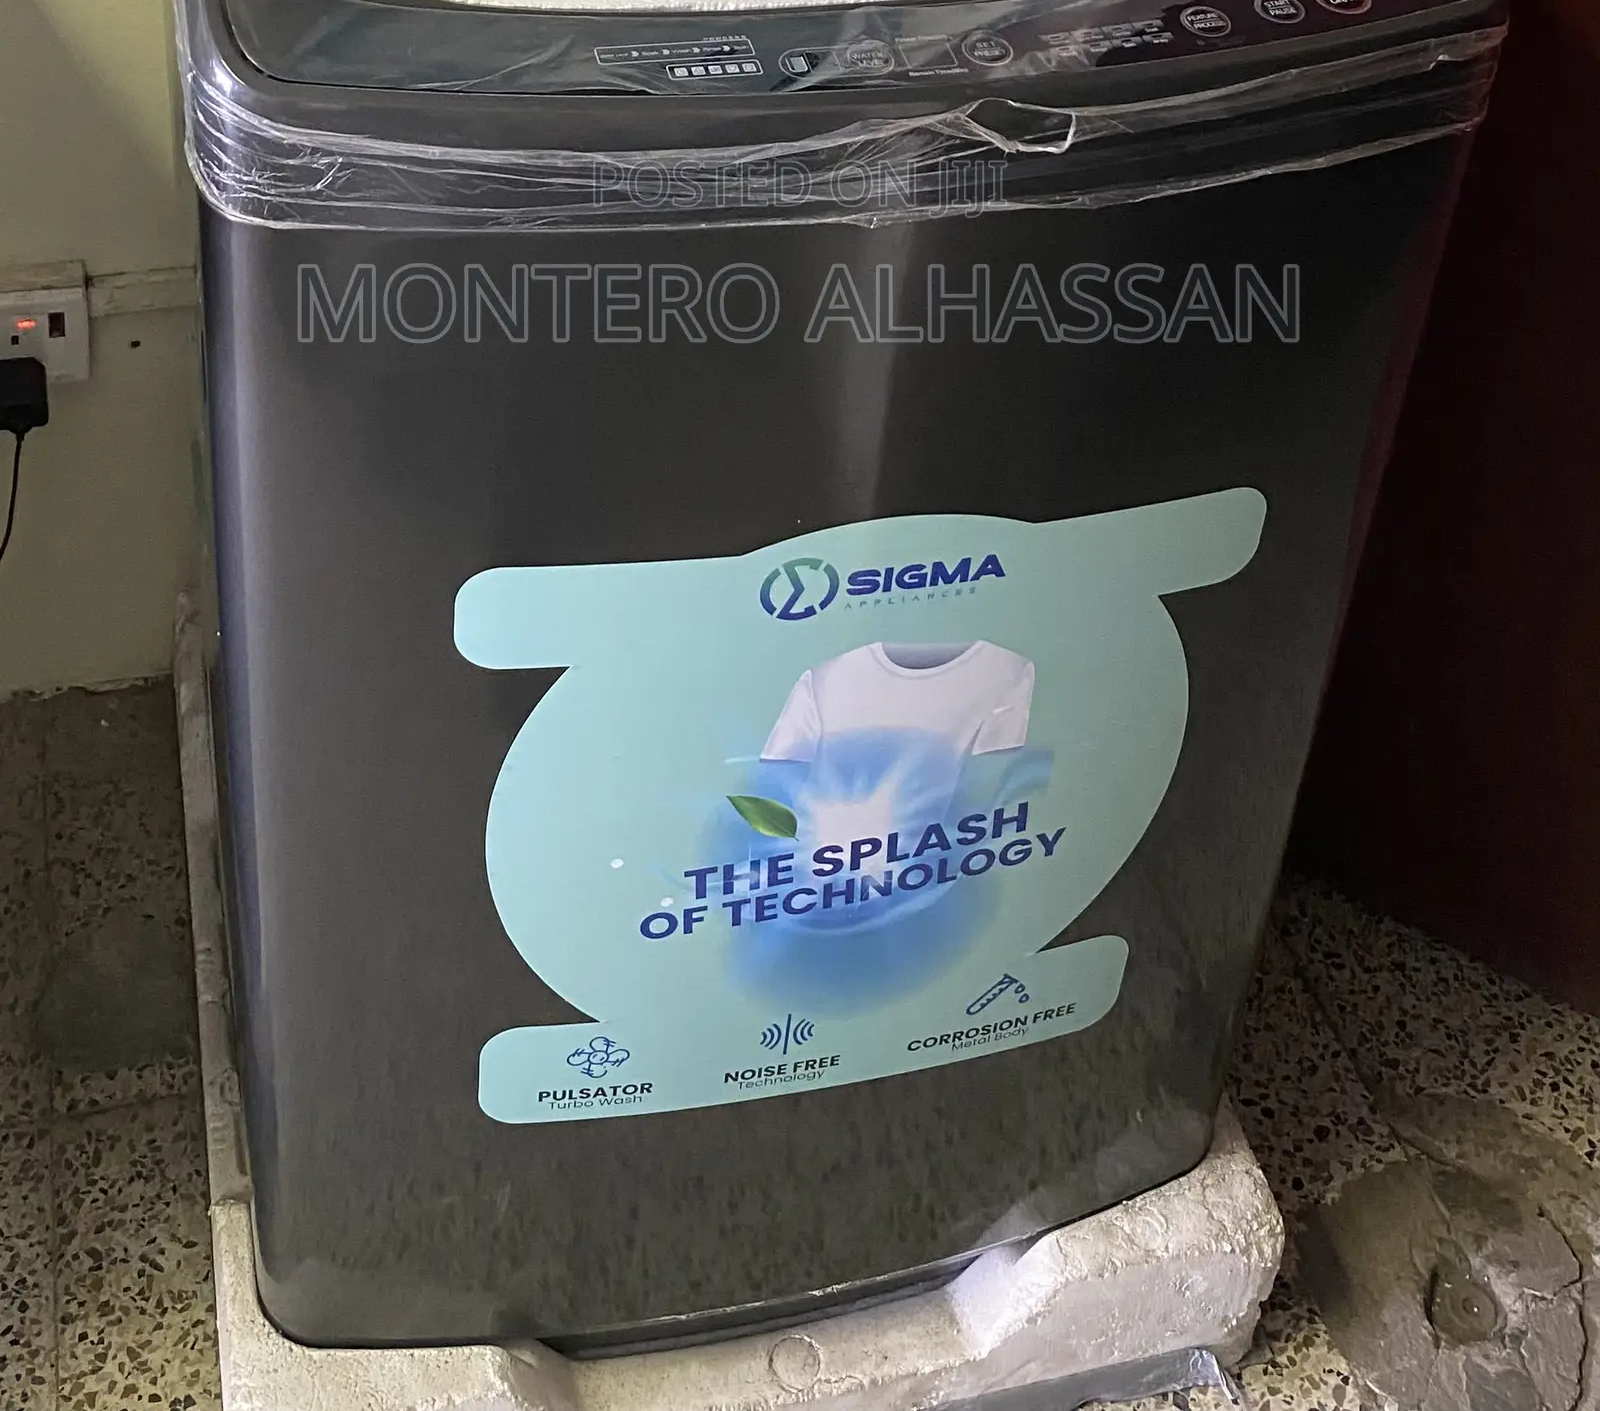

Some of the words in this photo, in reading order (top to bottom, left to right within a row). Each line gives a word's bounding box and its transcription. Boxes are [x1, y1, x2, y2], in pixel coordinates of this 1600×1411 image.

[1269, 6, 1297, 16] PAUSE
[846, 553, 1006, 596] SIGMA
[844, 586, 976, 610] APPLIANCES
[684, 852, 795, 900] THE
[812, 801, 1029, 877] SPLASH
[639, 905, 708, 940] OF
[722, 826, 1067, 927] TECHNOLOGY
[907, 1014, 1029, 1052] CORROSION
[1032, 1002, 1077, 1024] FREE
[951, 1035, 991, 1051] Metal
[994, 1026, 1029, 1042] Body
[724, 1063, 787, 1083] NOISE
[793, 1055, 841, 1070] FREE
[737, 1069, 825, 1090] Technology
[538, 1082, 653, 1103] PULSATOR
[548, 1098, 594, 1110] Turbo
[599, 1094, 642, 1106] Wash
